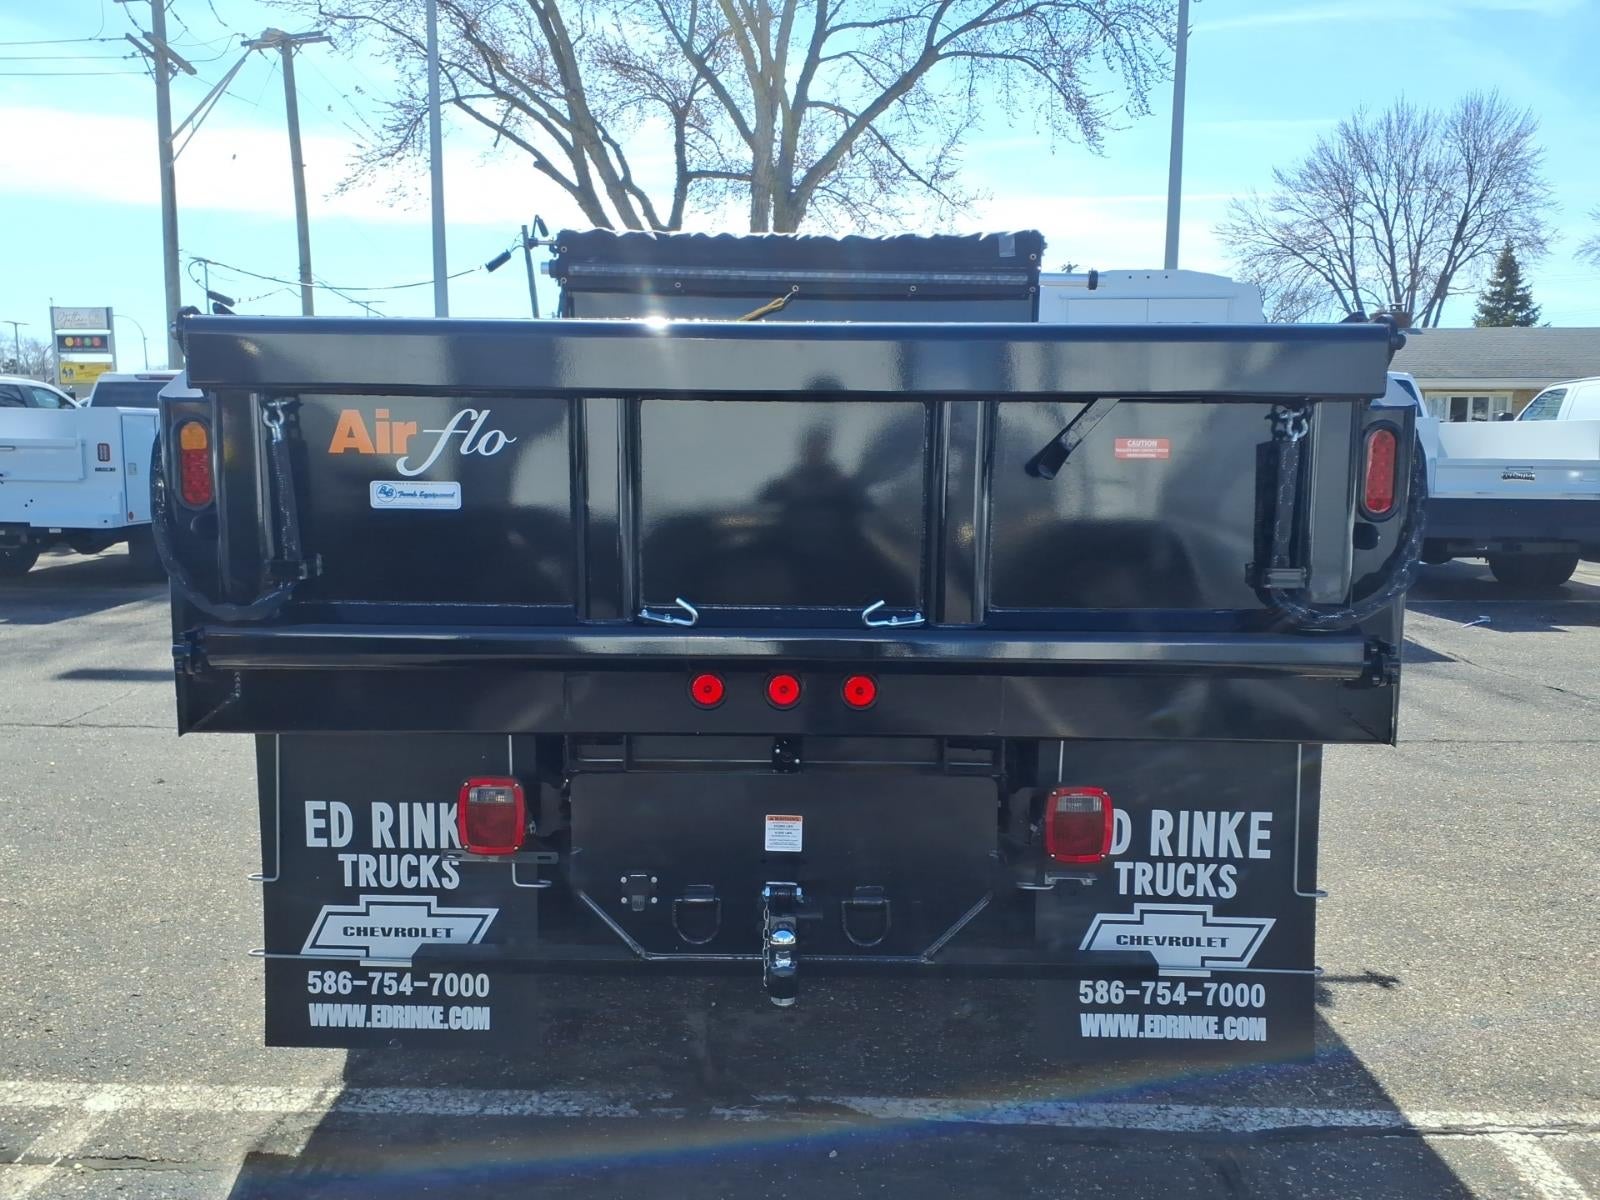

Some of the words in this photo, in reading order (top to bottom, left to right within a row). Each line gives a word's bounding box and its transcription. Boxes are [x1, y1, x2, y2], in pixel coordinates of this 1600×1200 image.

[328, 408, 417, 454] Air
[396, 408, 517, 476] flo
[1127, 439, 1158, 448] CAUTION
[305, 800, 353, 847] ED
[371, 802, 462, 849] RINK
[1110, 808, 1132, 855] D
[1150, 809, 1273, 859] RINKE
[338, 853, 460, 889] TRUCKS
[1114, 861, 1238, 899] TRUCKS
[342, 926, 454, 938] CHEVROLET
[1116, 934, 1229, 948] CHEVROLET
[307, 970, 490, 997] 586-754-7000
[1079, 980, 1266, 1007] 586-754-7000
[308, 1002, 490, 1030] WWW.EDRINKE.COM
[1080, 1013, 1267, 1041] WWW.EDRINKE.COM
